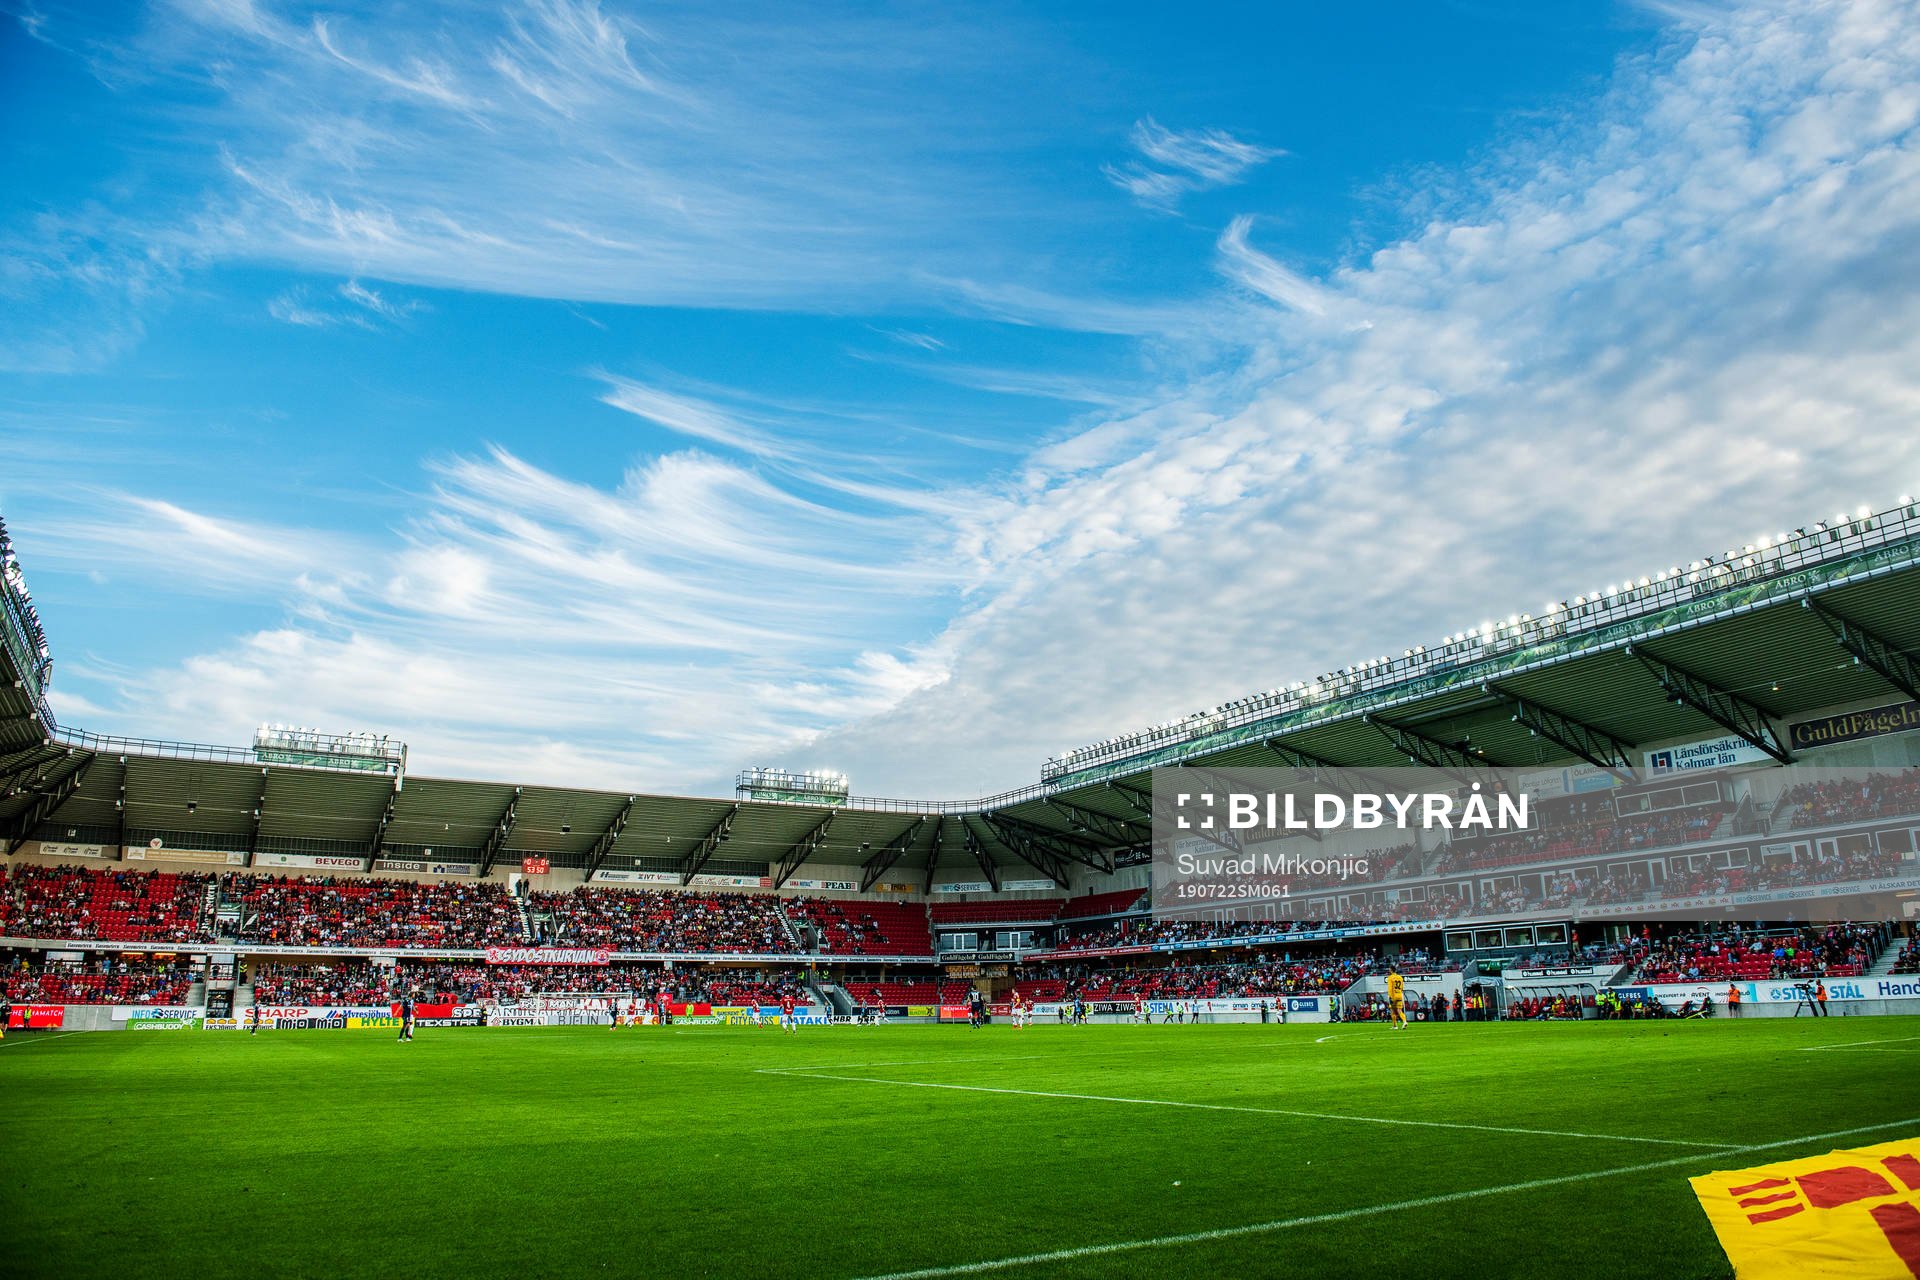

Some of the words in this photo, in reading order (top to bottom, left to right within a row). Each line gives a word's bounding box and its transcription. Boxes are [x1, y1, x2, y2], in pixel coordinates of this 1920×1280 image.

[1674, 735, 1767, 760] Länsförsäkring
[1676, 757, 1716, 772] Kalmar
[1718, 753, 1736, 765] län
[315, 857, 360, 867] BEVEGO
[383, 861, 420, 870] inside
[825, 881, 851, 890] PEAB
[1839, 886, 1860, 894] SERVICE
[1752, 893, 1772, 902] SERVICE
[1795, 890, 1815, 899] SERVICE
[1394, 980, 1402, 990] 32
[1830, 981, 1864, 998] STÅL
[1094, 1003, 1112, 1011] ZIWA
[1115, 1002, 1134, 1011] ZIWA
[12, 1009, 63, 1017] HEAMATCH
[132, 1009, 150, 1019] INFO
[163, 1009, 197, 1019] SERVICE
[245, 1008, 308, 1018] SHARP
[361, 1017, 399, 1027] HYLTE
[415, 1018, 478, 1027] TEXSTAR
